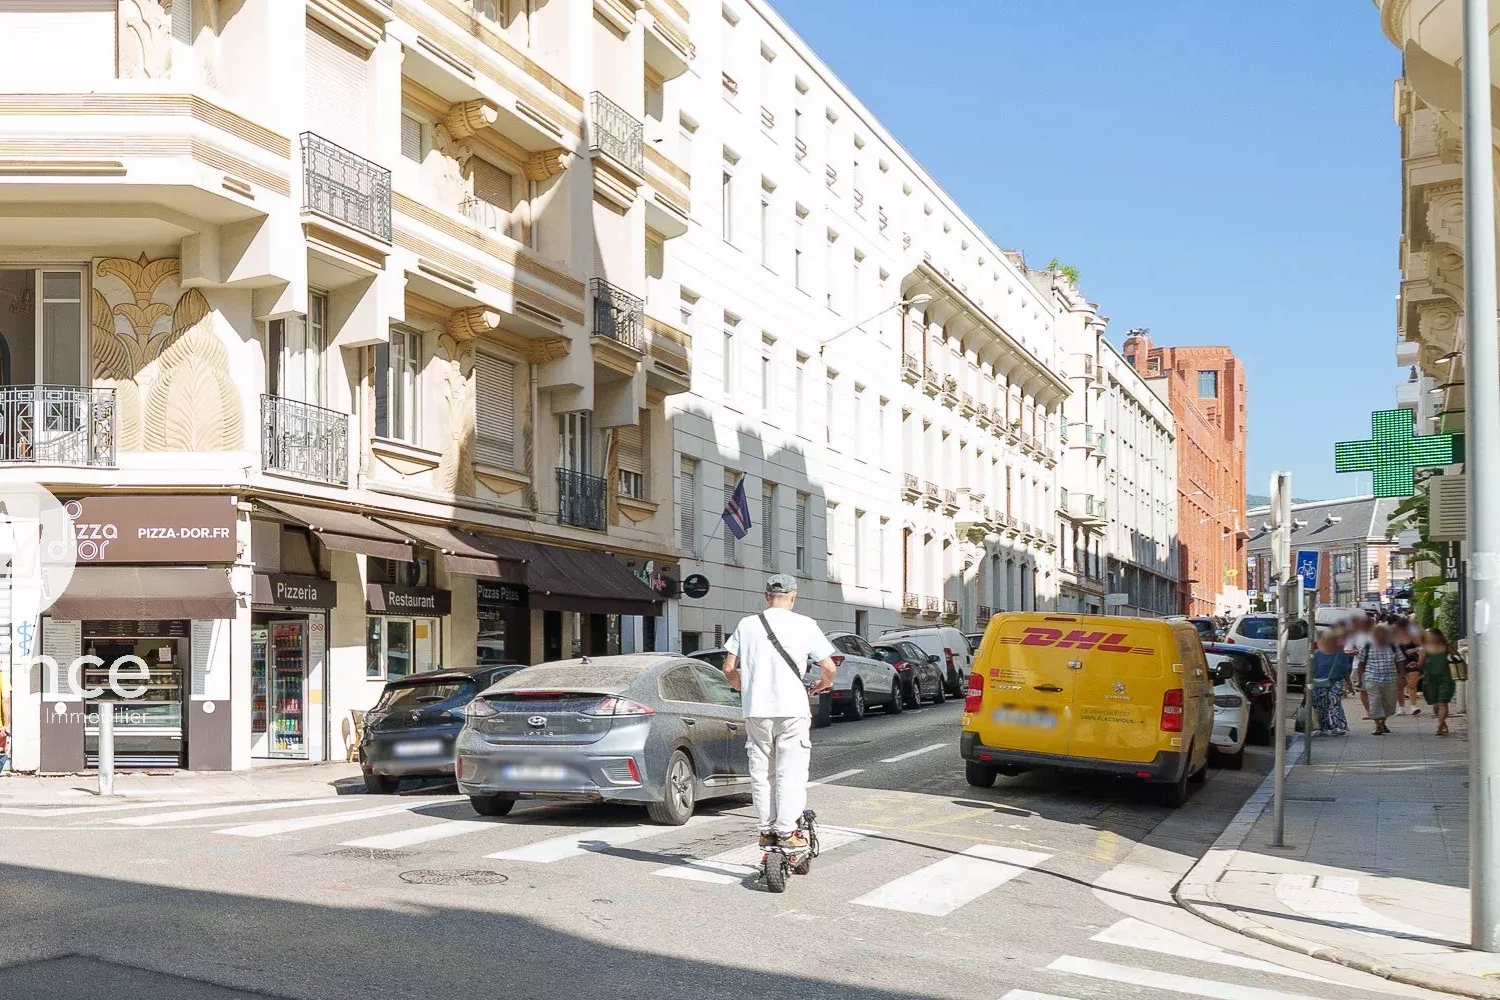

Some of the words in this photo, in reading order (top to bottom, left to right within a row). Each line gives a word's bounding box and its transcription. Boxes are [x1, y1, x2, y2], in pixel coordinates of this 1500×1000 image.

[138, 527, 230, 538] PIZZA-DOR.FR
[277, 582, 317, 600] Pizzeria
[388, 591, 436, 608] Restaurant
[478, 584, 500, 599] Pizzas
[1020, 627, 1133, 653] DHL
